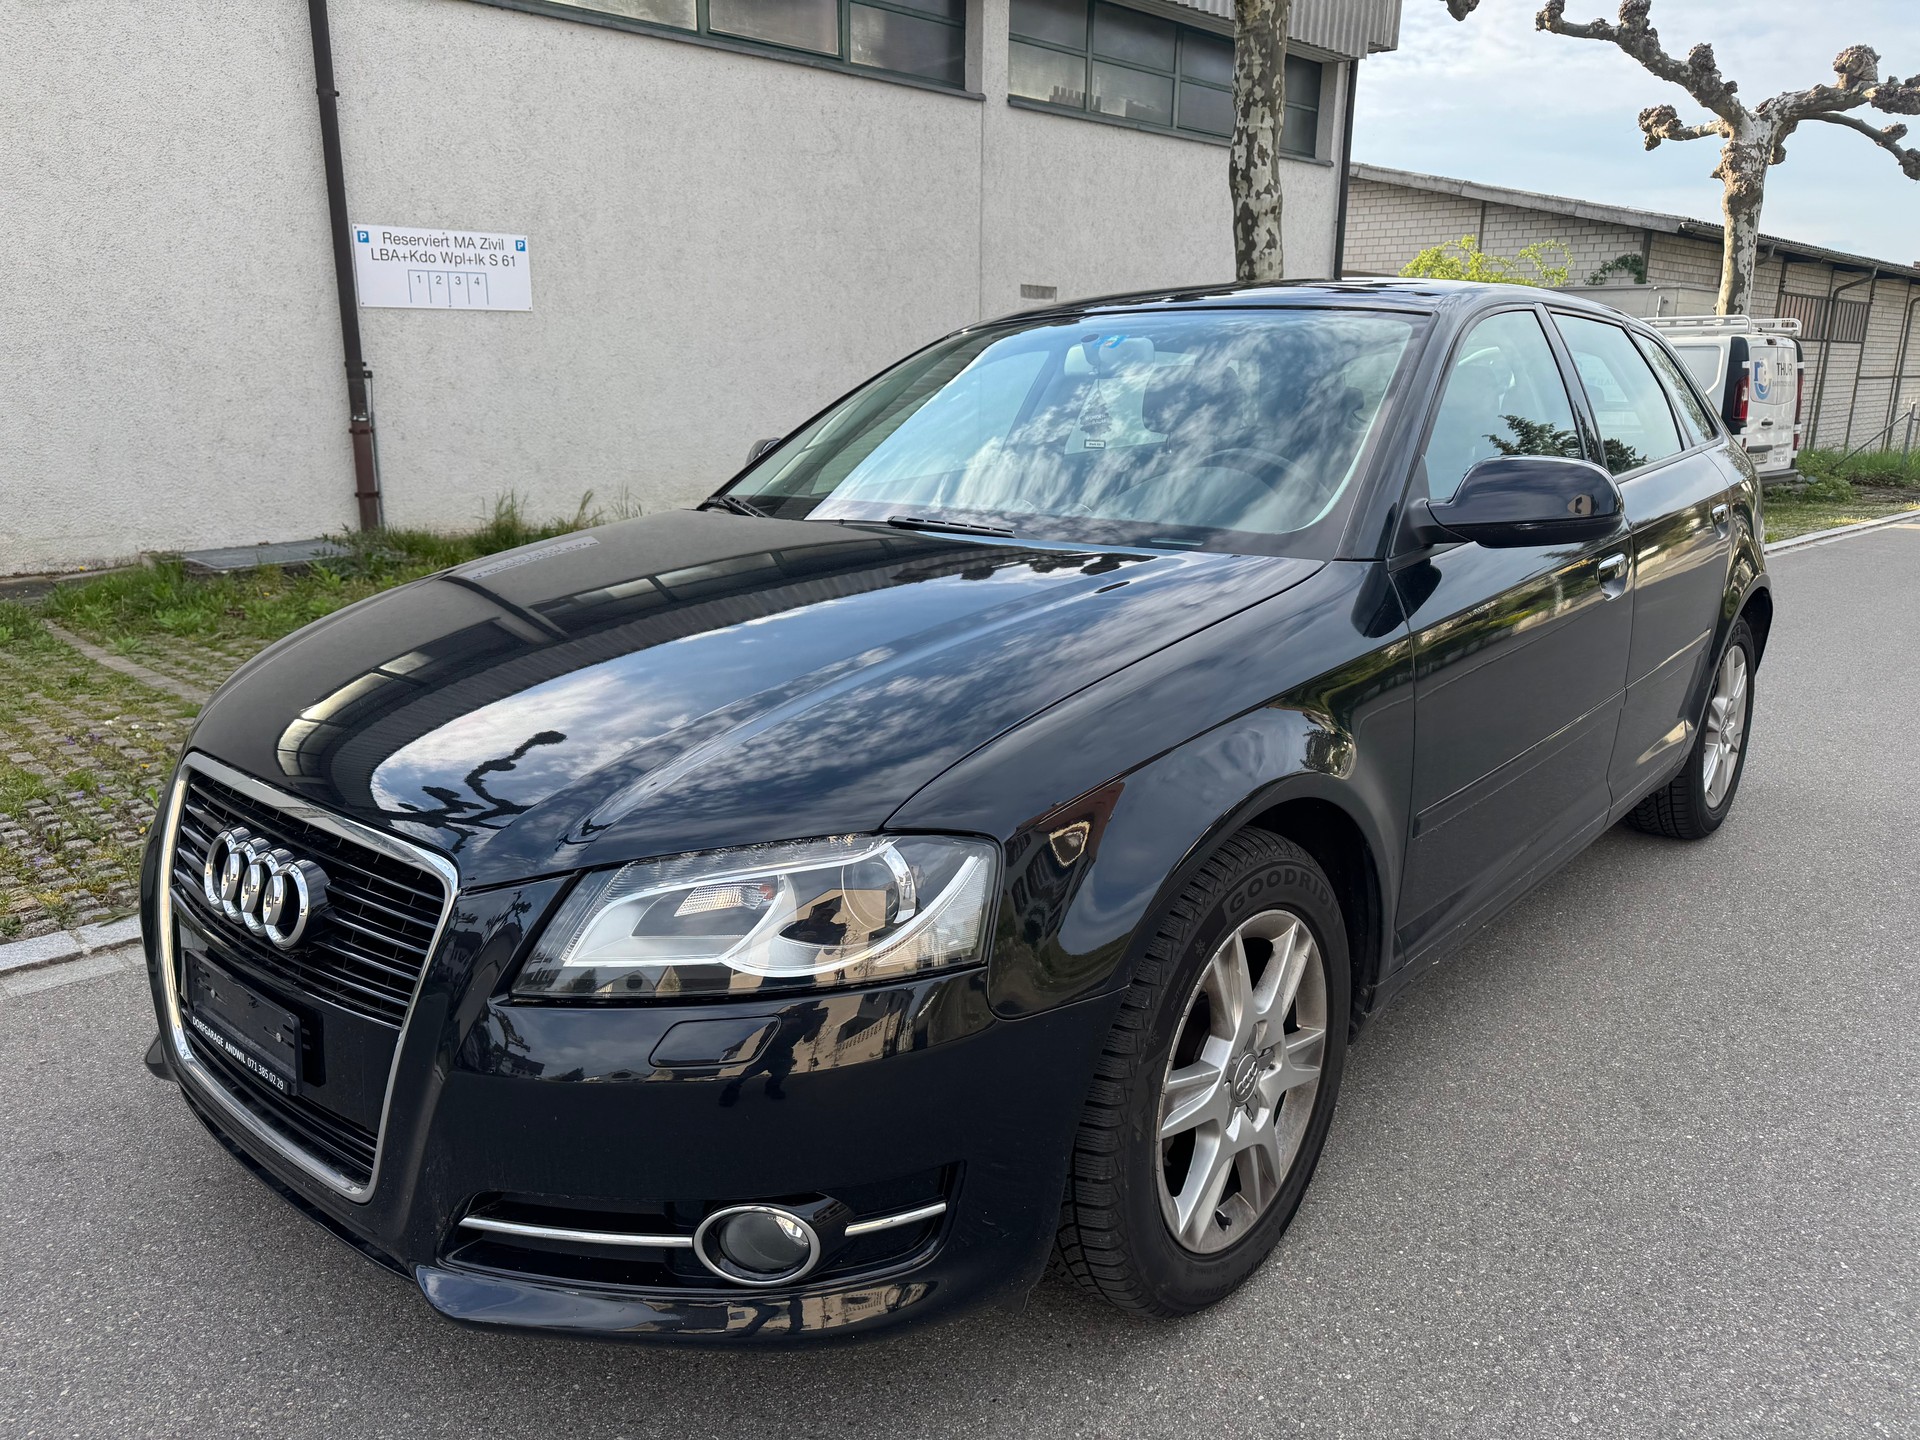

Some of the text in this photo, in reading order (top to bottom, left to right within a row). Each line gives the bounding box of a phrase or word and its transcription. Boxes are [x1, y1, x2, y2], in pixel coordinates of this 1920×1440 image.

[382, 232, 505, 251] Reserviert MA Zivil
[371, 248, 437, 264] LBA+Kdo
[489, 254, 498, 267] S
[501, 255, 516, 267] 61
[416, 275, 480, 286] 1 2 3 4
[1776, 362, 1793, 376] THUR
[225, 1041, 246, 1064] ANDWIL
[247, 1057, 258, 1072] 071
[258, 1065, 269, 1079] 385
[268, 1072, 276, 1085] 02
[276, 1075, 284, 1090] 29
